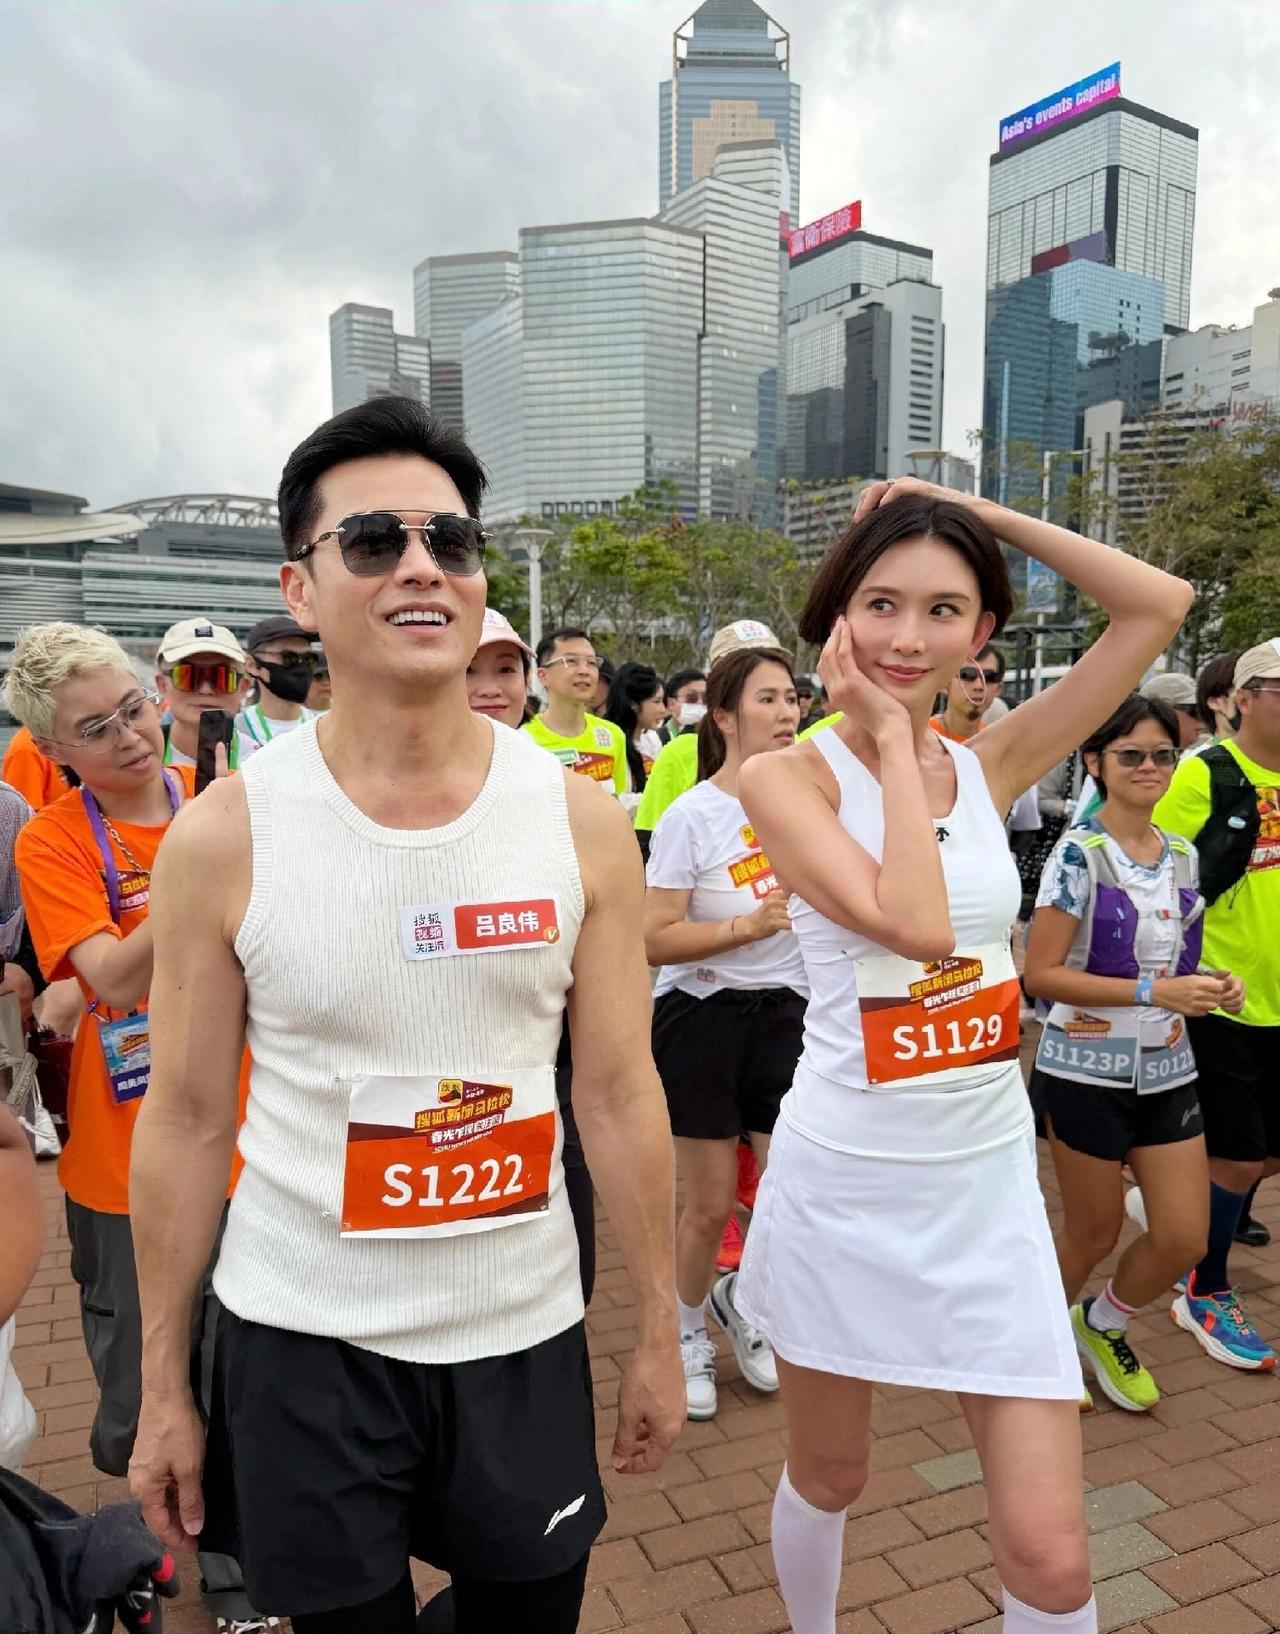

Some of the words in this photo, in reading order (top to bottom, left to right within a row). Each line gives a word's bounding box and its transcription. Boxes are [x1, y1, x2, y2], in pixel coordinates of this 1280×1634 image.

[1001, 116, 1033, 142] Asia's
[1035, 96, 1073, 124] events
[1075, 73, 1116, 107] capital
[413, 911, 442, 927] 搜狐
[415, 927, 443, 941] 视频
[476, 910, 539, 938] 吕良伟
[893, 1014, 1003, 1061] S1129
[1042, 1039, 1130, 1074] S1123P
[416, 1093, 511, 1129] 搜狐新闻马拉松
[381, 1153, 524, 1207] S1222
